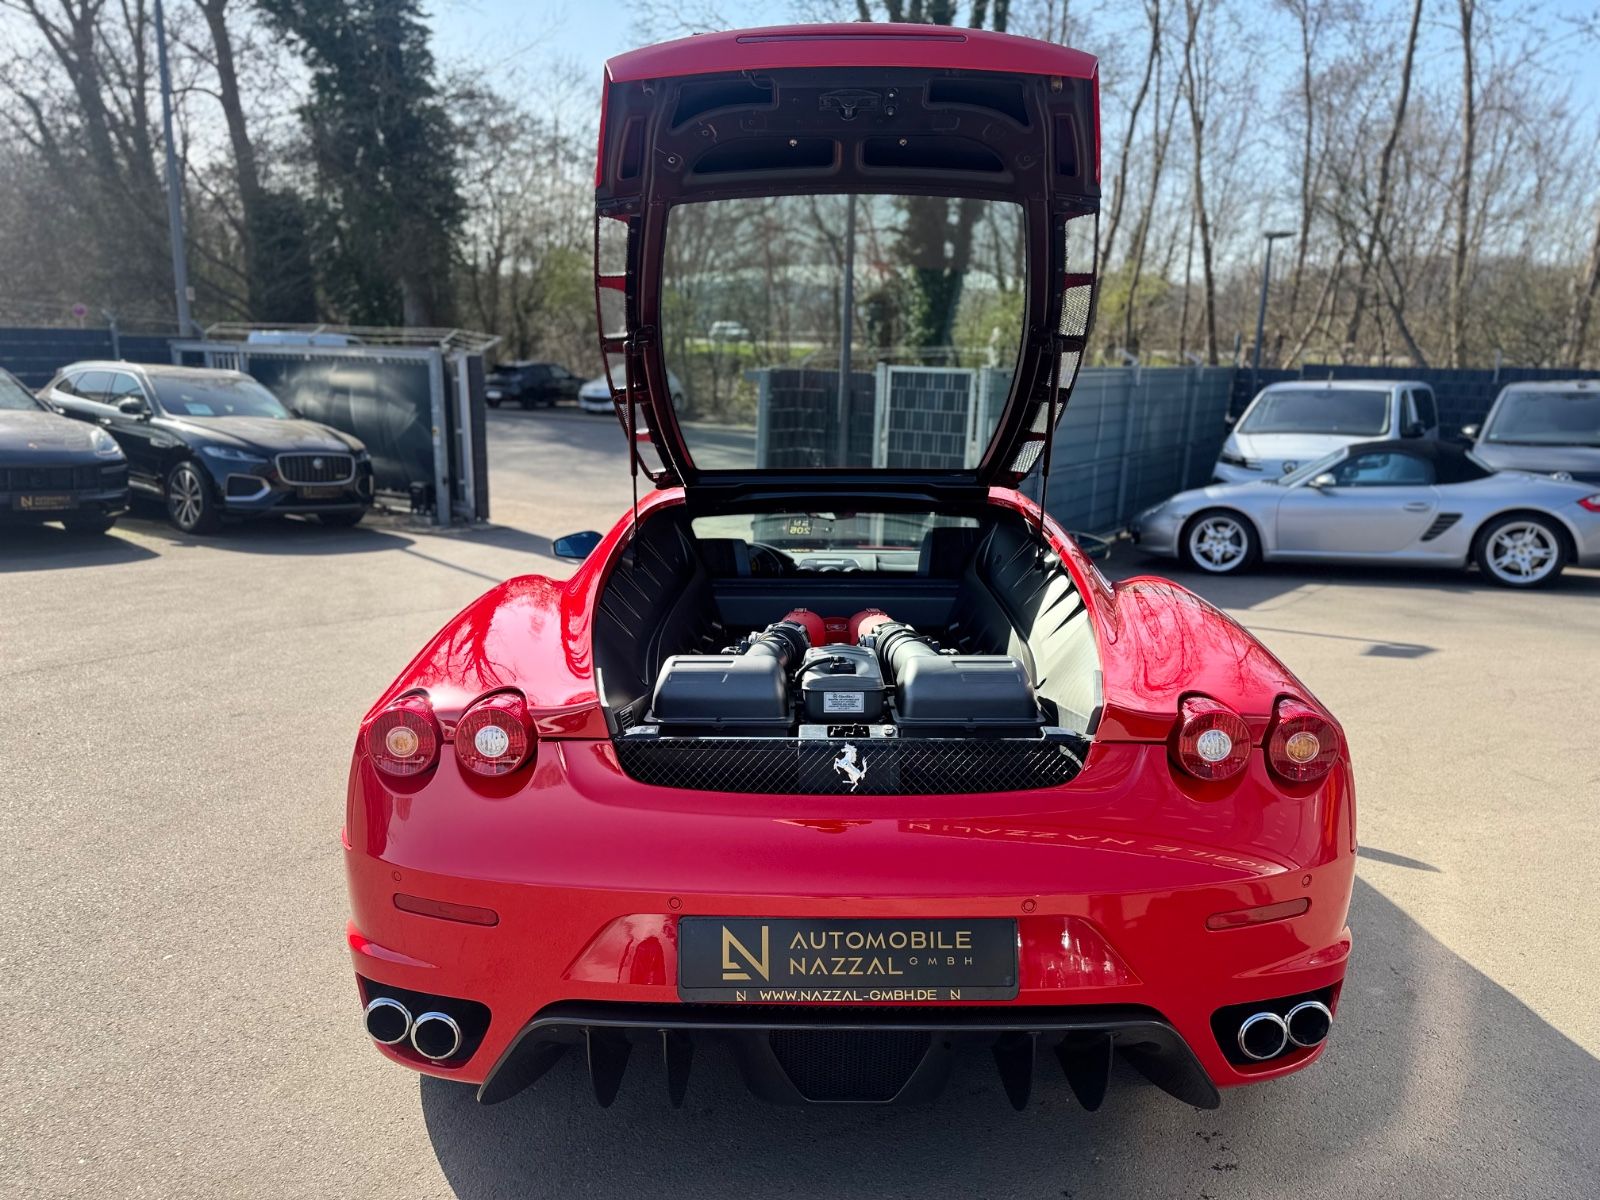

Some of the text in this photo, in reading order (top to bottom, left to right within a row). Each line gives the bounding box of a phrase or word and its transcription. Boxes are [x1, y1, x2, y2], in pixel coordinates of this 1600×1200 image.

[789, 931, 972, 950] AUTOMOBILE
[789, 957, 904, 975] NAZZAL
[760, 989, 938, 1002] WWW.NAZZAL-GMBH.DE
